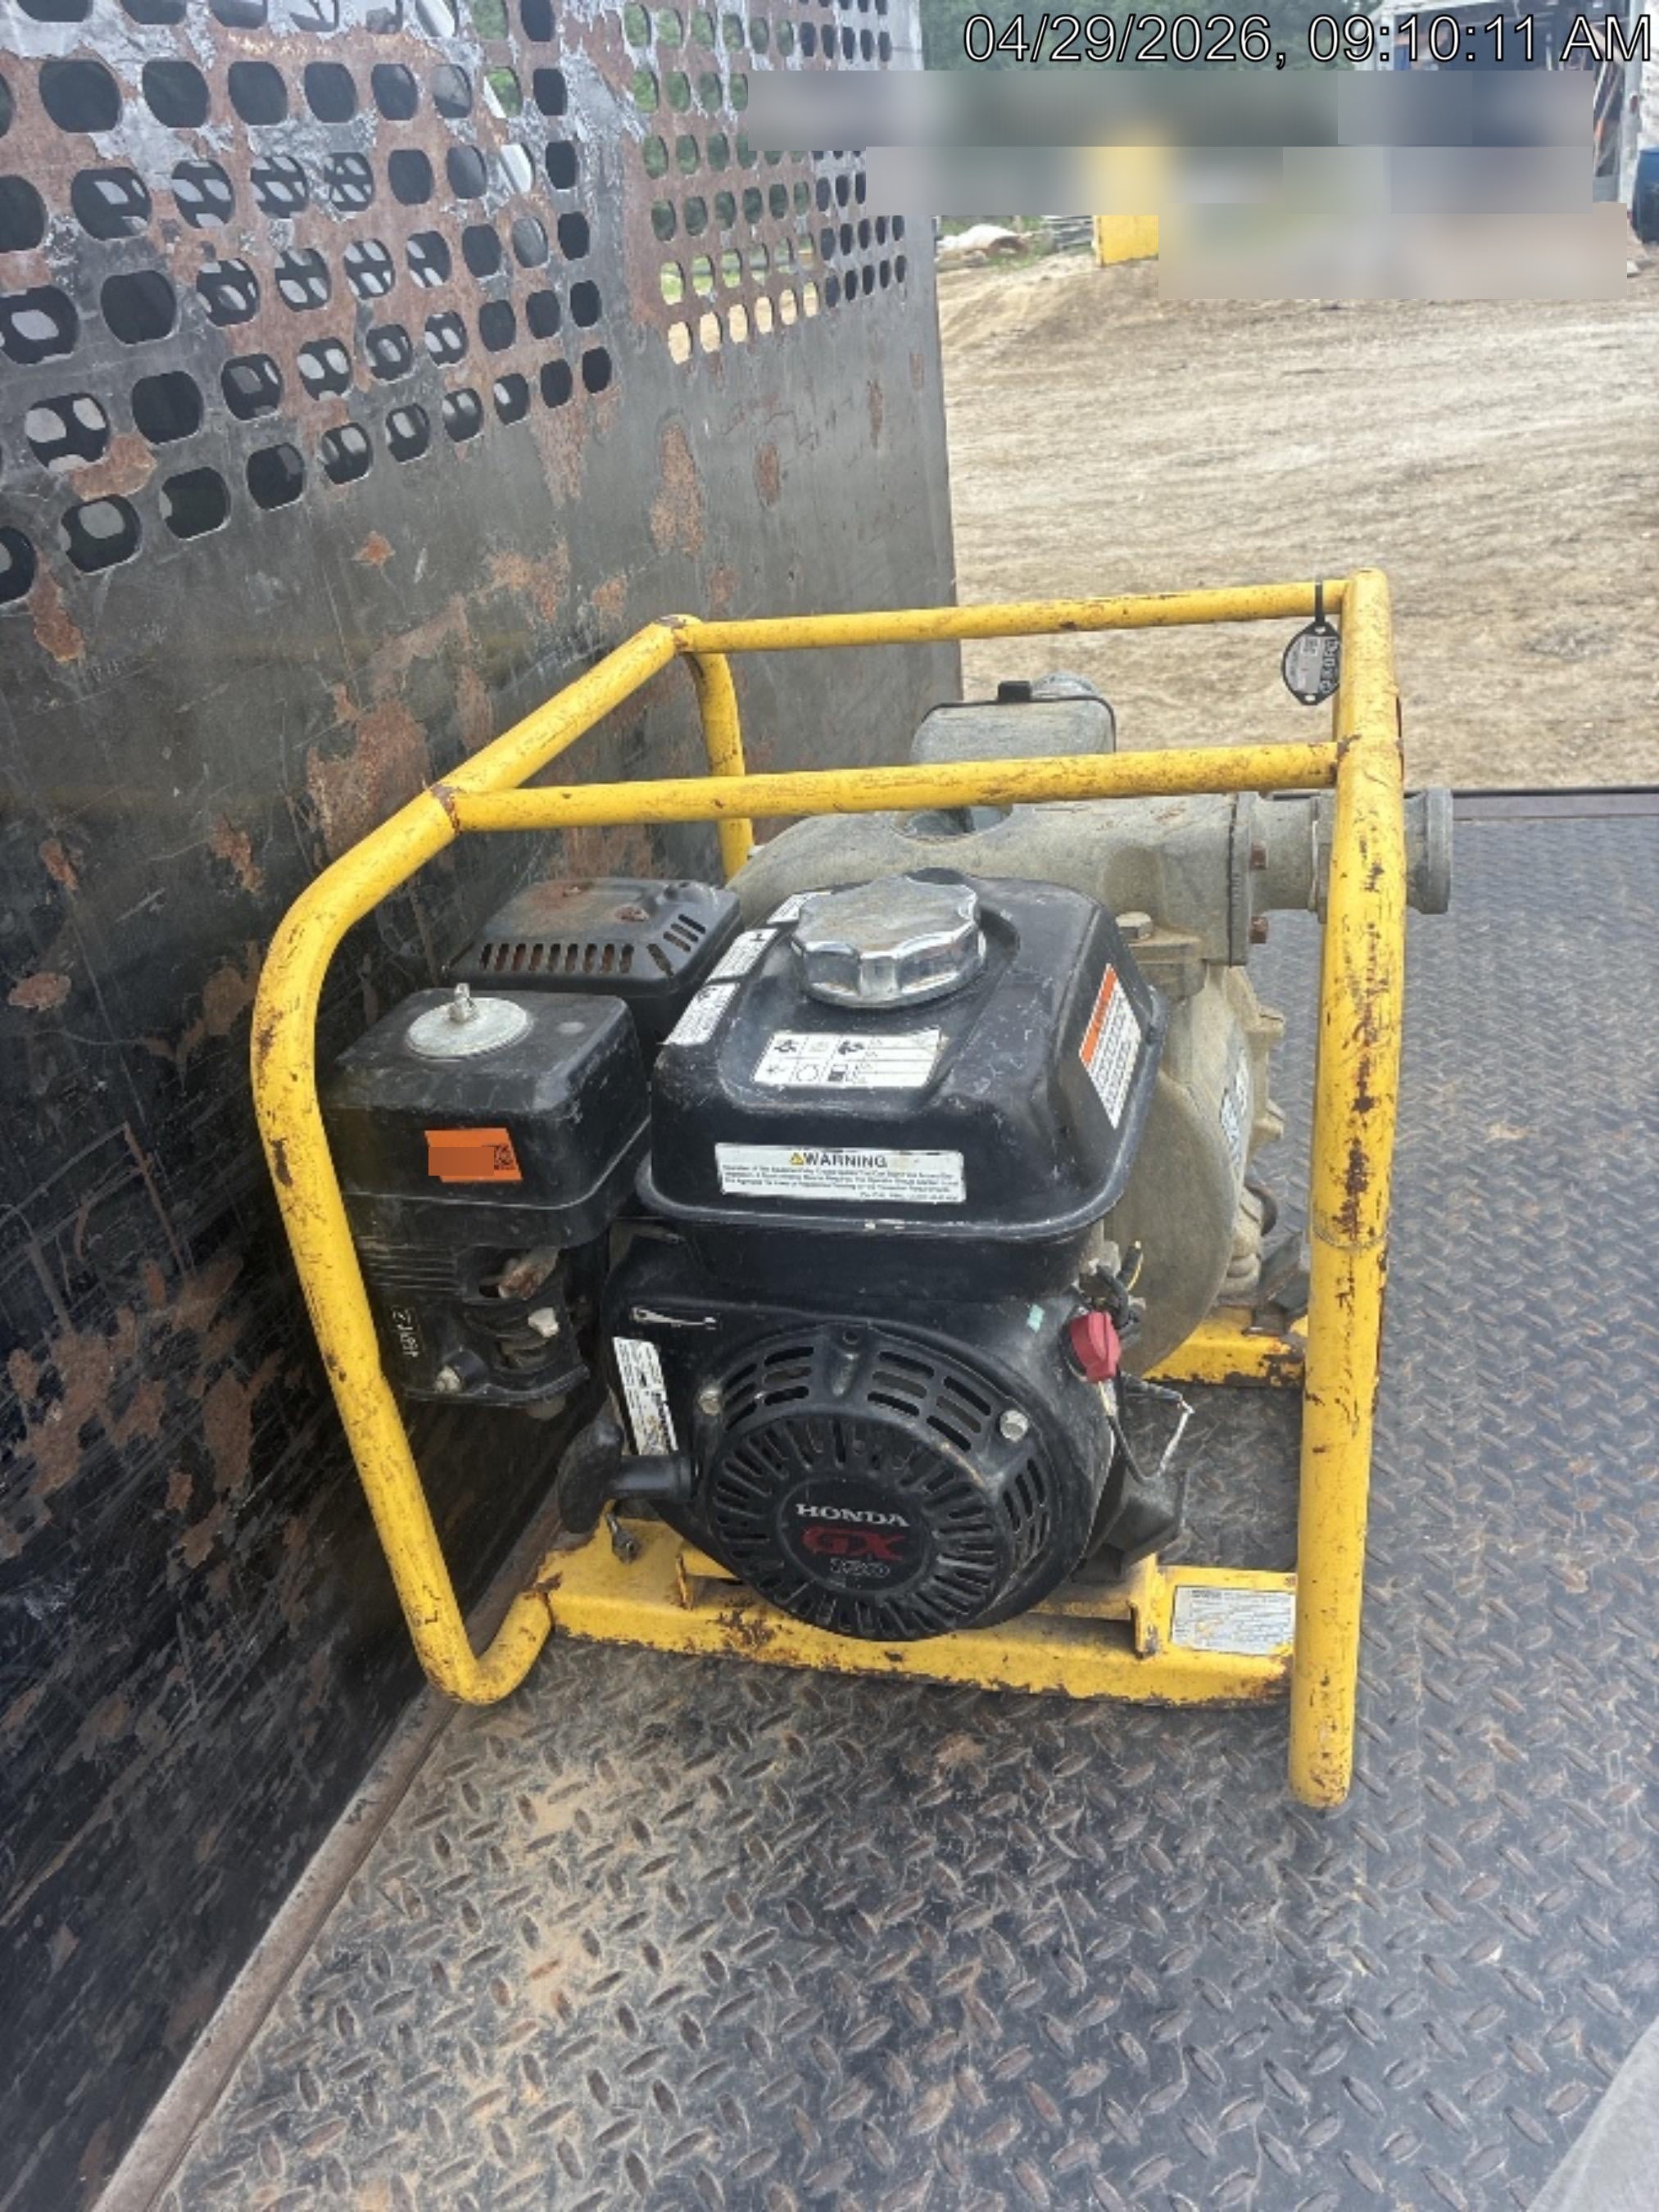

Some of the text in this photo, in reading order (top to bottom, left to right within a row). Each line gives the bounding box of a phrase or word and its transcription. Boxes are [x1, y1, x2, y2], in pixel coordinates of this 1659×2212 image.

[804, 1152, 887, 1167] WARNING
[796, 1503, 910, 1527] HONDA
[802, 1526, 904, 1561] GX
